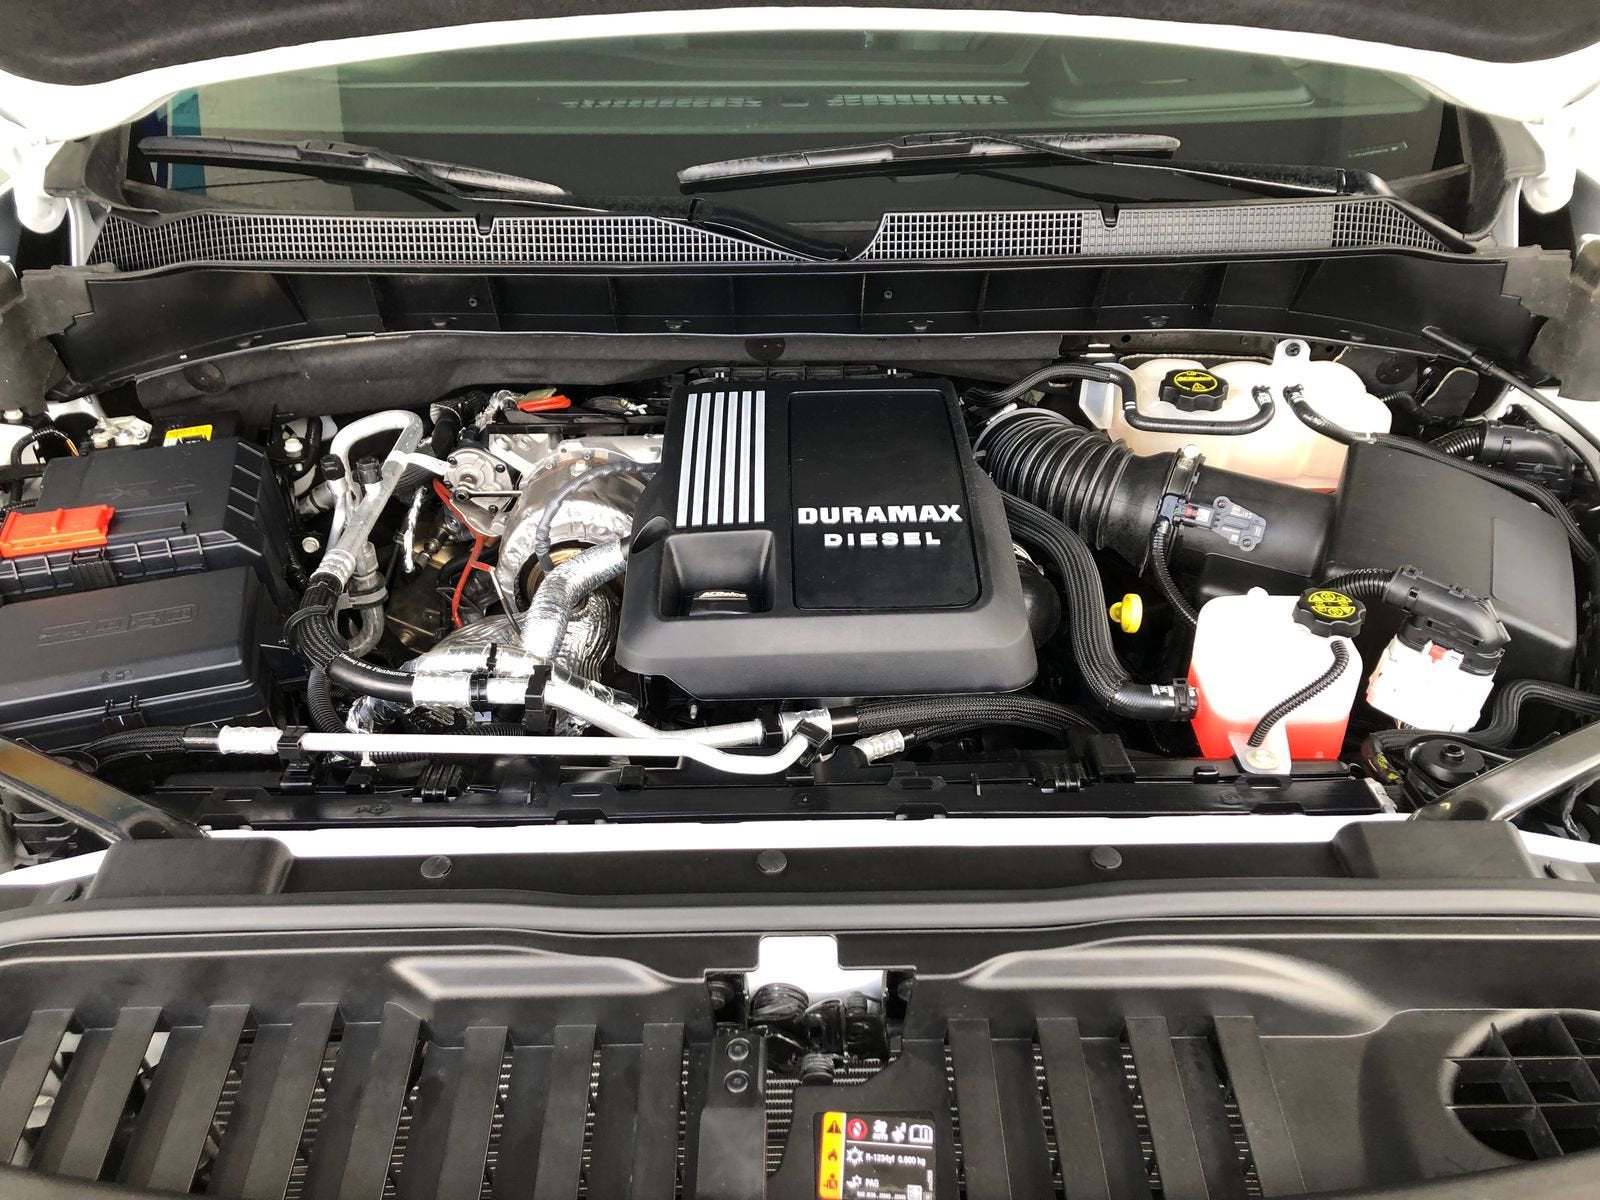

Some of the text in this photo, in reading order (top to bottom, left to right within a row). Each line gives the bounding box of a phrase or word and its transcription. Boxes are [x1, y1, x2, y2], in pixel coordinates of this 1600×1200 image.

[798, 505, 963, 524] DURAMAX
[824, 532, 941, 547] DIESEL
[917, 1157, 926, 1167] kg
[865, 1178, 879, 1188] PAG
